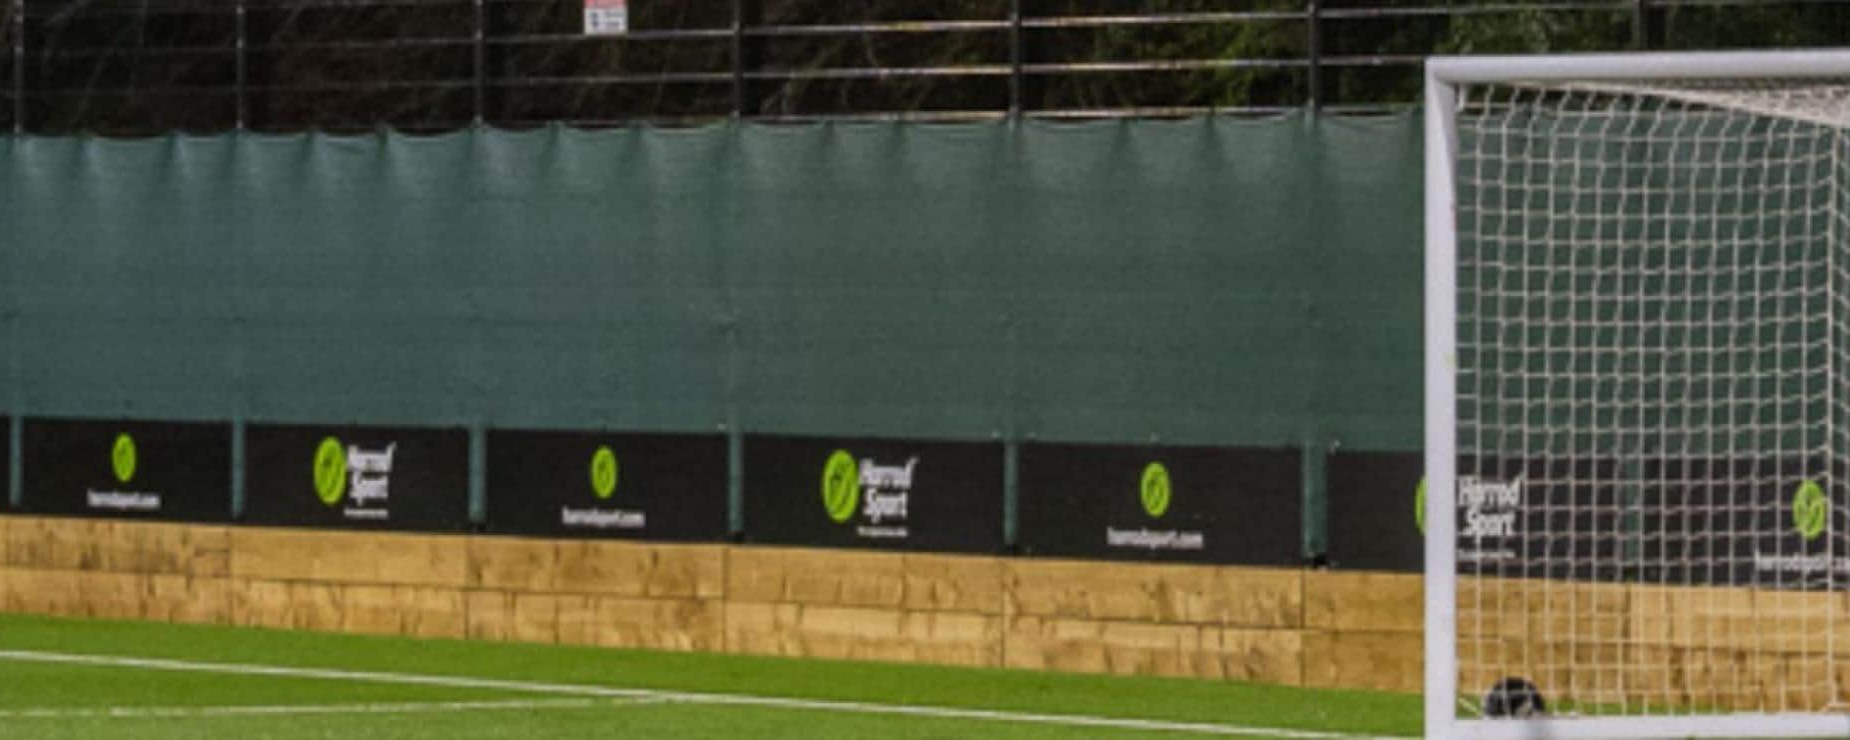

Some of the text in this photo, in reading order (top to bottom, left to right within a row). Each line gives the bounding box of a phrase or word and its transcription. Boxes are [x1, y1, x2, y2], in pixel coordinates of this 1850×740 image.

[346, 441, 397, 472] Harrod
[859, 456, 920, 489] Harrod
[349, 471, 389, 506] Sport
[863, 487, 909, 524] Sport
[1458, 472, 1523, 506] Harrod
[1463, 504, 1516, 544] Sport
